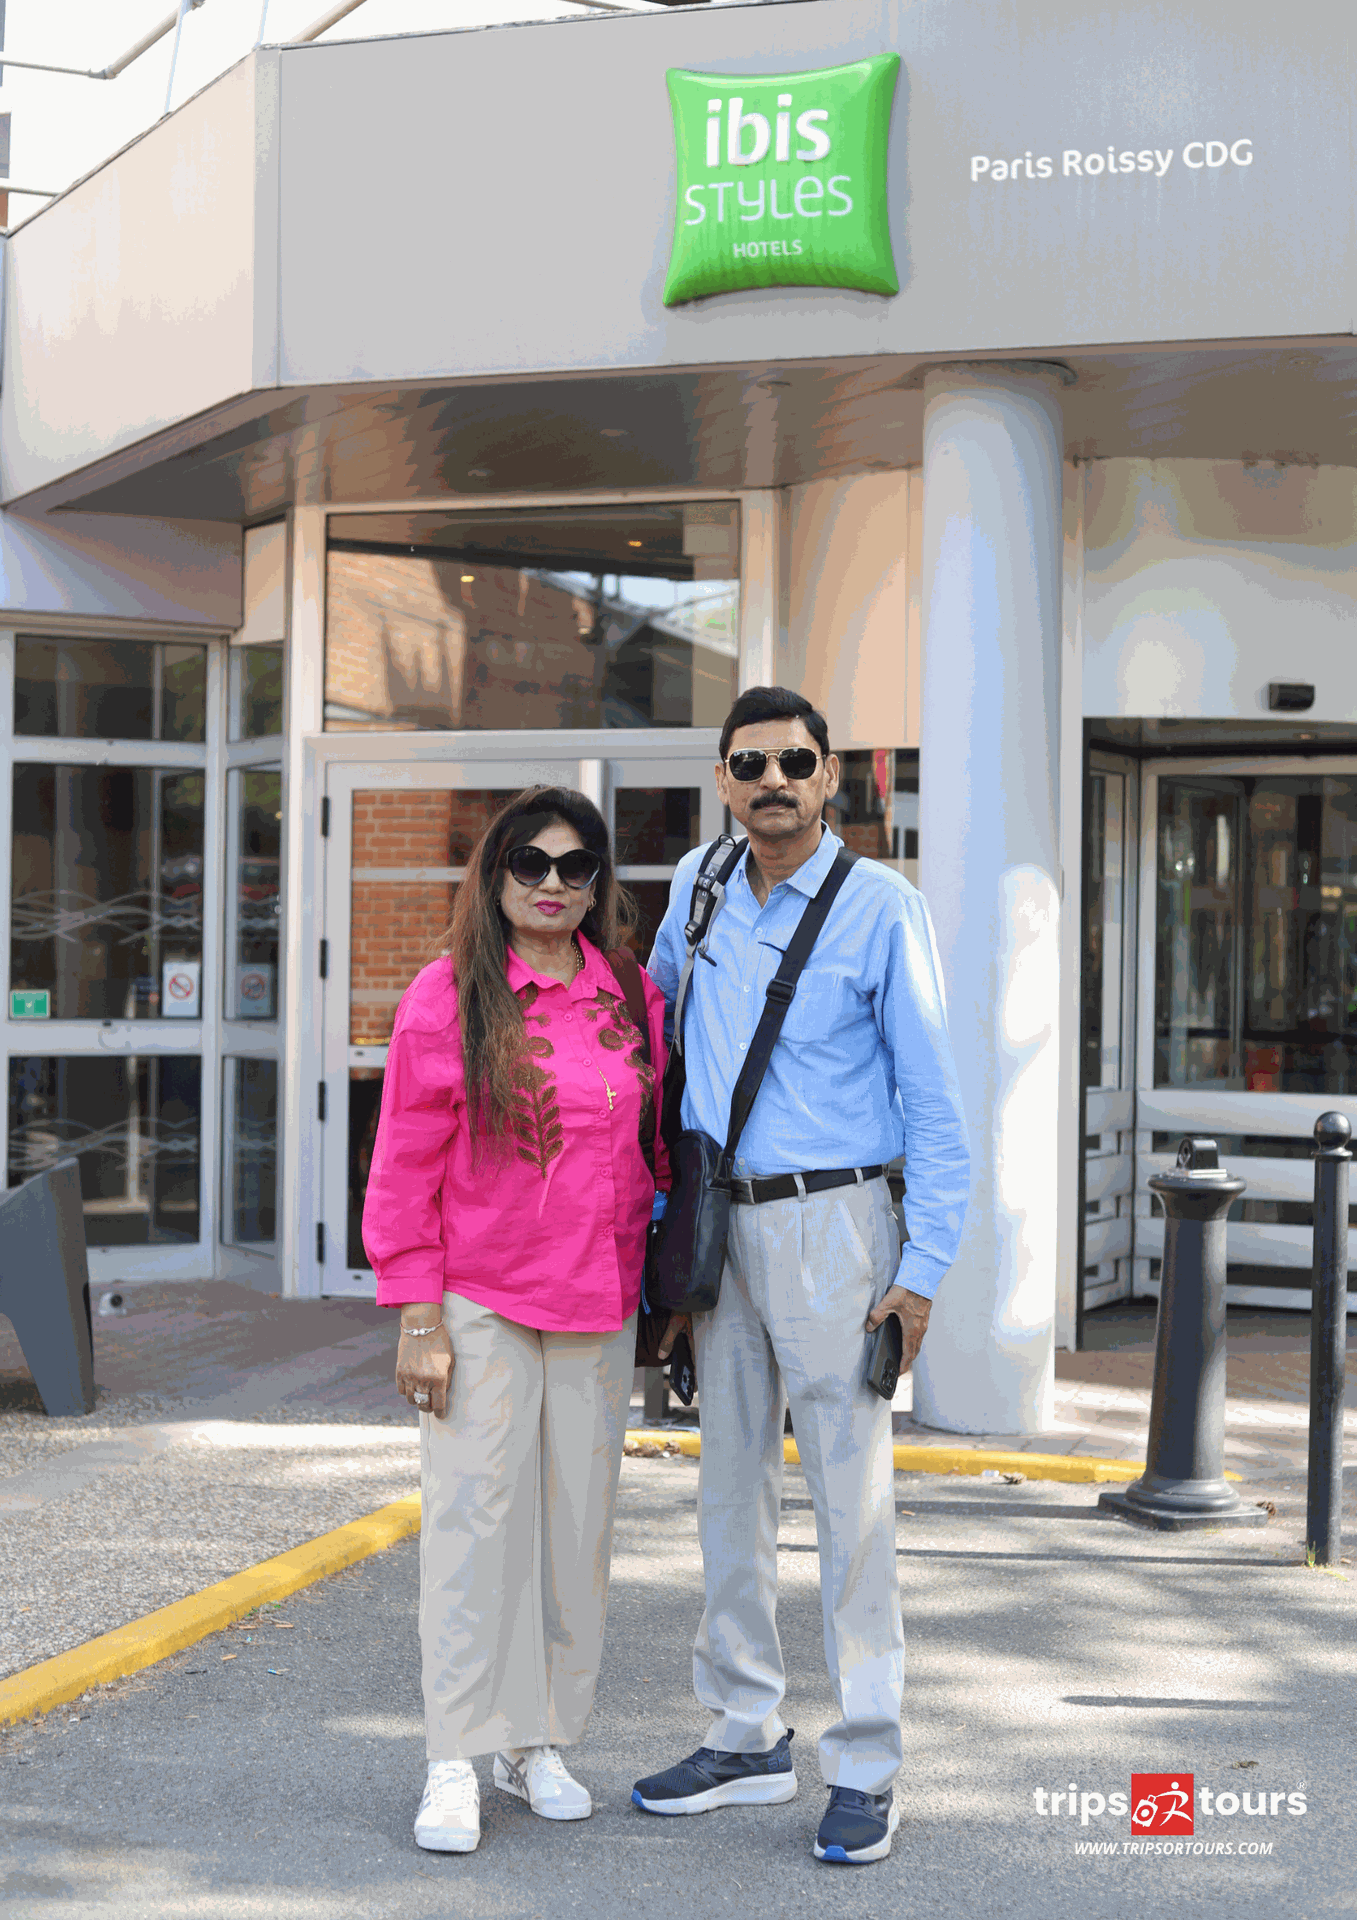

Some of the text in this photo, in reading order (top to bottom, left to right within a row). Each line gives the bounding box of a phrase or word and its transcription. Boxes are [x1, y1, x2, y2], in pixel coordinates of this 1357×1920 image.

[705, 93, 832, 168] ibis
[970, 138, 1254, 183] Paris Roissy CDG
[732, 239, 803, 259] HOTELS
